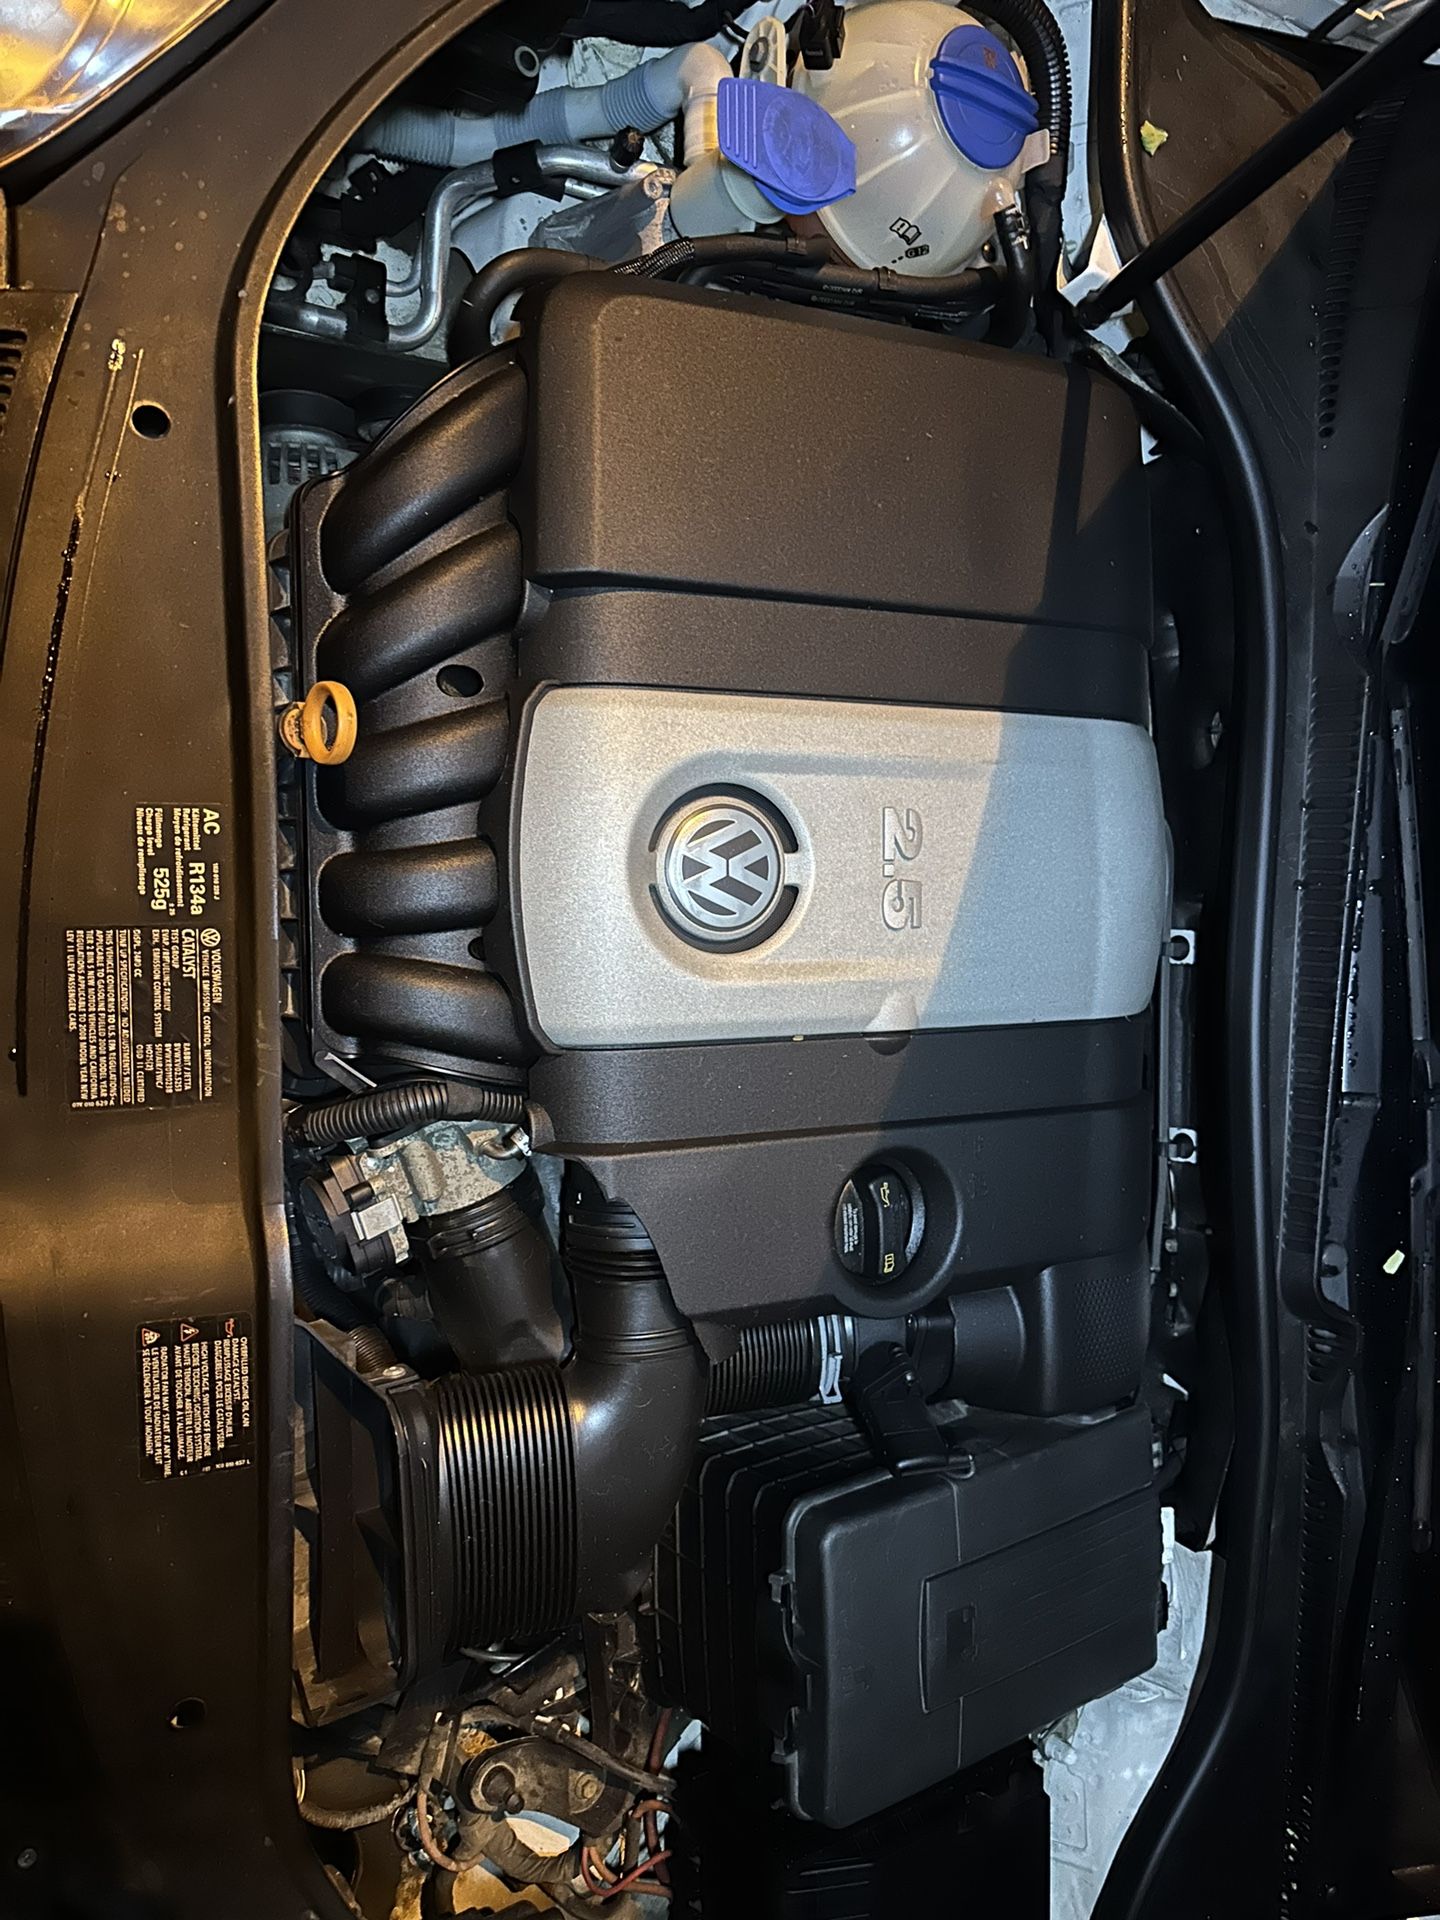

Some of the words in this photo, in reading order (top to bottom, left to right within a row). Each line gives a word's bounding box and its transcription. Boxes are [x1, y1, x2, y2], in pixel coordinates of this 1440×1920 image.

[136, 808, 144, 834] Niveau
[145, 808, 153, 835] Charge
[155, 808, 163, 848] Füllmenge
[172, 808, 181, 834] Moyen
[182, 808, 191, 851] Refrigerant
[203, 808, 220, 834] AC
[138, 837, 145, 846] de
[147, 837, 155, 856] level
[175, 836, 182, 845] de
[137, 849, 146, 895] remplissage
[175, 848, 184, 907] refroidissement
[881, 806, 923, 931] 2.5
[151, 868, 170, 910] 525g
[189, 862, 206, 915] R134a
[66, 930, 74, 944] LEV
[86, 930, 94, 944] TIER
[95, 930, 104, 966] APPLICABLE
[105, 930, 113, 945] THIS
[171, 929, 179, 944] TEST
[67, 955, 75, 971] ULEV
[76, 930, 85, 973] REGULATIONS
[86, 951, 94, 964] BIN
[105, 947, 114, 973] VEHICLE
[120, 949, 127, 958] UP
[171, 945, 179, 968] GROUP
[182, 929, 195, 979] CATALYST
[202, 949, 210, 976] VEHICLE
[96, 968, 104, 977] TO
[134, 969, 142, 977] CC
[152, 948, 160, 979] EMISSION
[87, 970, 95, 986] NEW
[211, 949, 222, 1003] VOLKSWAGEN
[67, 974, 76, 1011] PASSENGER
[77, 975, 86, 1012] APPLICABLE
[87, 988, 95, 1011] MOTOR
[97, 979, 105, 1011] GASOLINE
[106, 975, 114, 1012] CONFORMS
[153, 981, 161, 1011] CONTROL
[68, 1013, 77, 1032] CARS.
[78, 1014, 86, 1022] TO
[88, 1014, 96, 1043] VEHICLES
[98, 1013, 106, 1036] FUELED
[107, 1014, 115, 1023] TO
[121, 1017, 128, 1027] NO
[203, 1016, 211, 1046] CONTROL
[79, 1042, 87, 1065] MODEL
[98, 1038, 106, 1055] 2008
[80, 1067, 88, 1082] YEAR
[99, 1056, 107, 1079] MODEL
[80, 1084, 88, 1099] NEW
[89, 1061, 97, 1099] CALIFORNIA
[99, 1081, 107, 1097] YEAR
[136, 1071, 145, 1102] CERTIFIED
[142, 1349, 150, 1357] SE
[151, 1347, 159, 1356] LE
[174, 1345, 182, 1368] AVANT
[183, 1344, 191, 1366] HAUTE
[192, 1343, 200, 1366] BEFORE
[214, 1340, 222, 1380] DANGEREUX
[223, 1339, 231, 1381] REMPLISSAGE
[240, 1337, 248, 1374] OVERFILLED
[152, 1357, 160, 1400] VENTILATEUR
[175, 1370, 182, 1378] DE
[193, 1368, 201, 1402] TOUCHING
[175, 1379, 183, 1409] TOUCHER
[215, 1381, 223, 1399] POUR
[224, 1383, 232, 1411] EXCESSIF
[241, 1376, 249, 1399] ENGINE
[144, 1406, 152, 1424] TOUT
[153, 1402, 160, 1410] DE
[202, 1394, 210, 1419] SWITCH
[216, 1400, 223, 1408] LE
[154, 1411, 162, 1448] RADIATEUR
[162, 1413, 170, 1433] START
[225, 1412, 233, 1437] D'HUILE
[163, 1435, 170, 1443] AT
[163, 1445, 171, 1459] ANY
